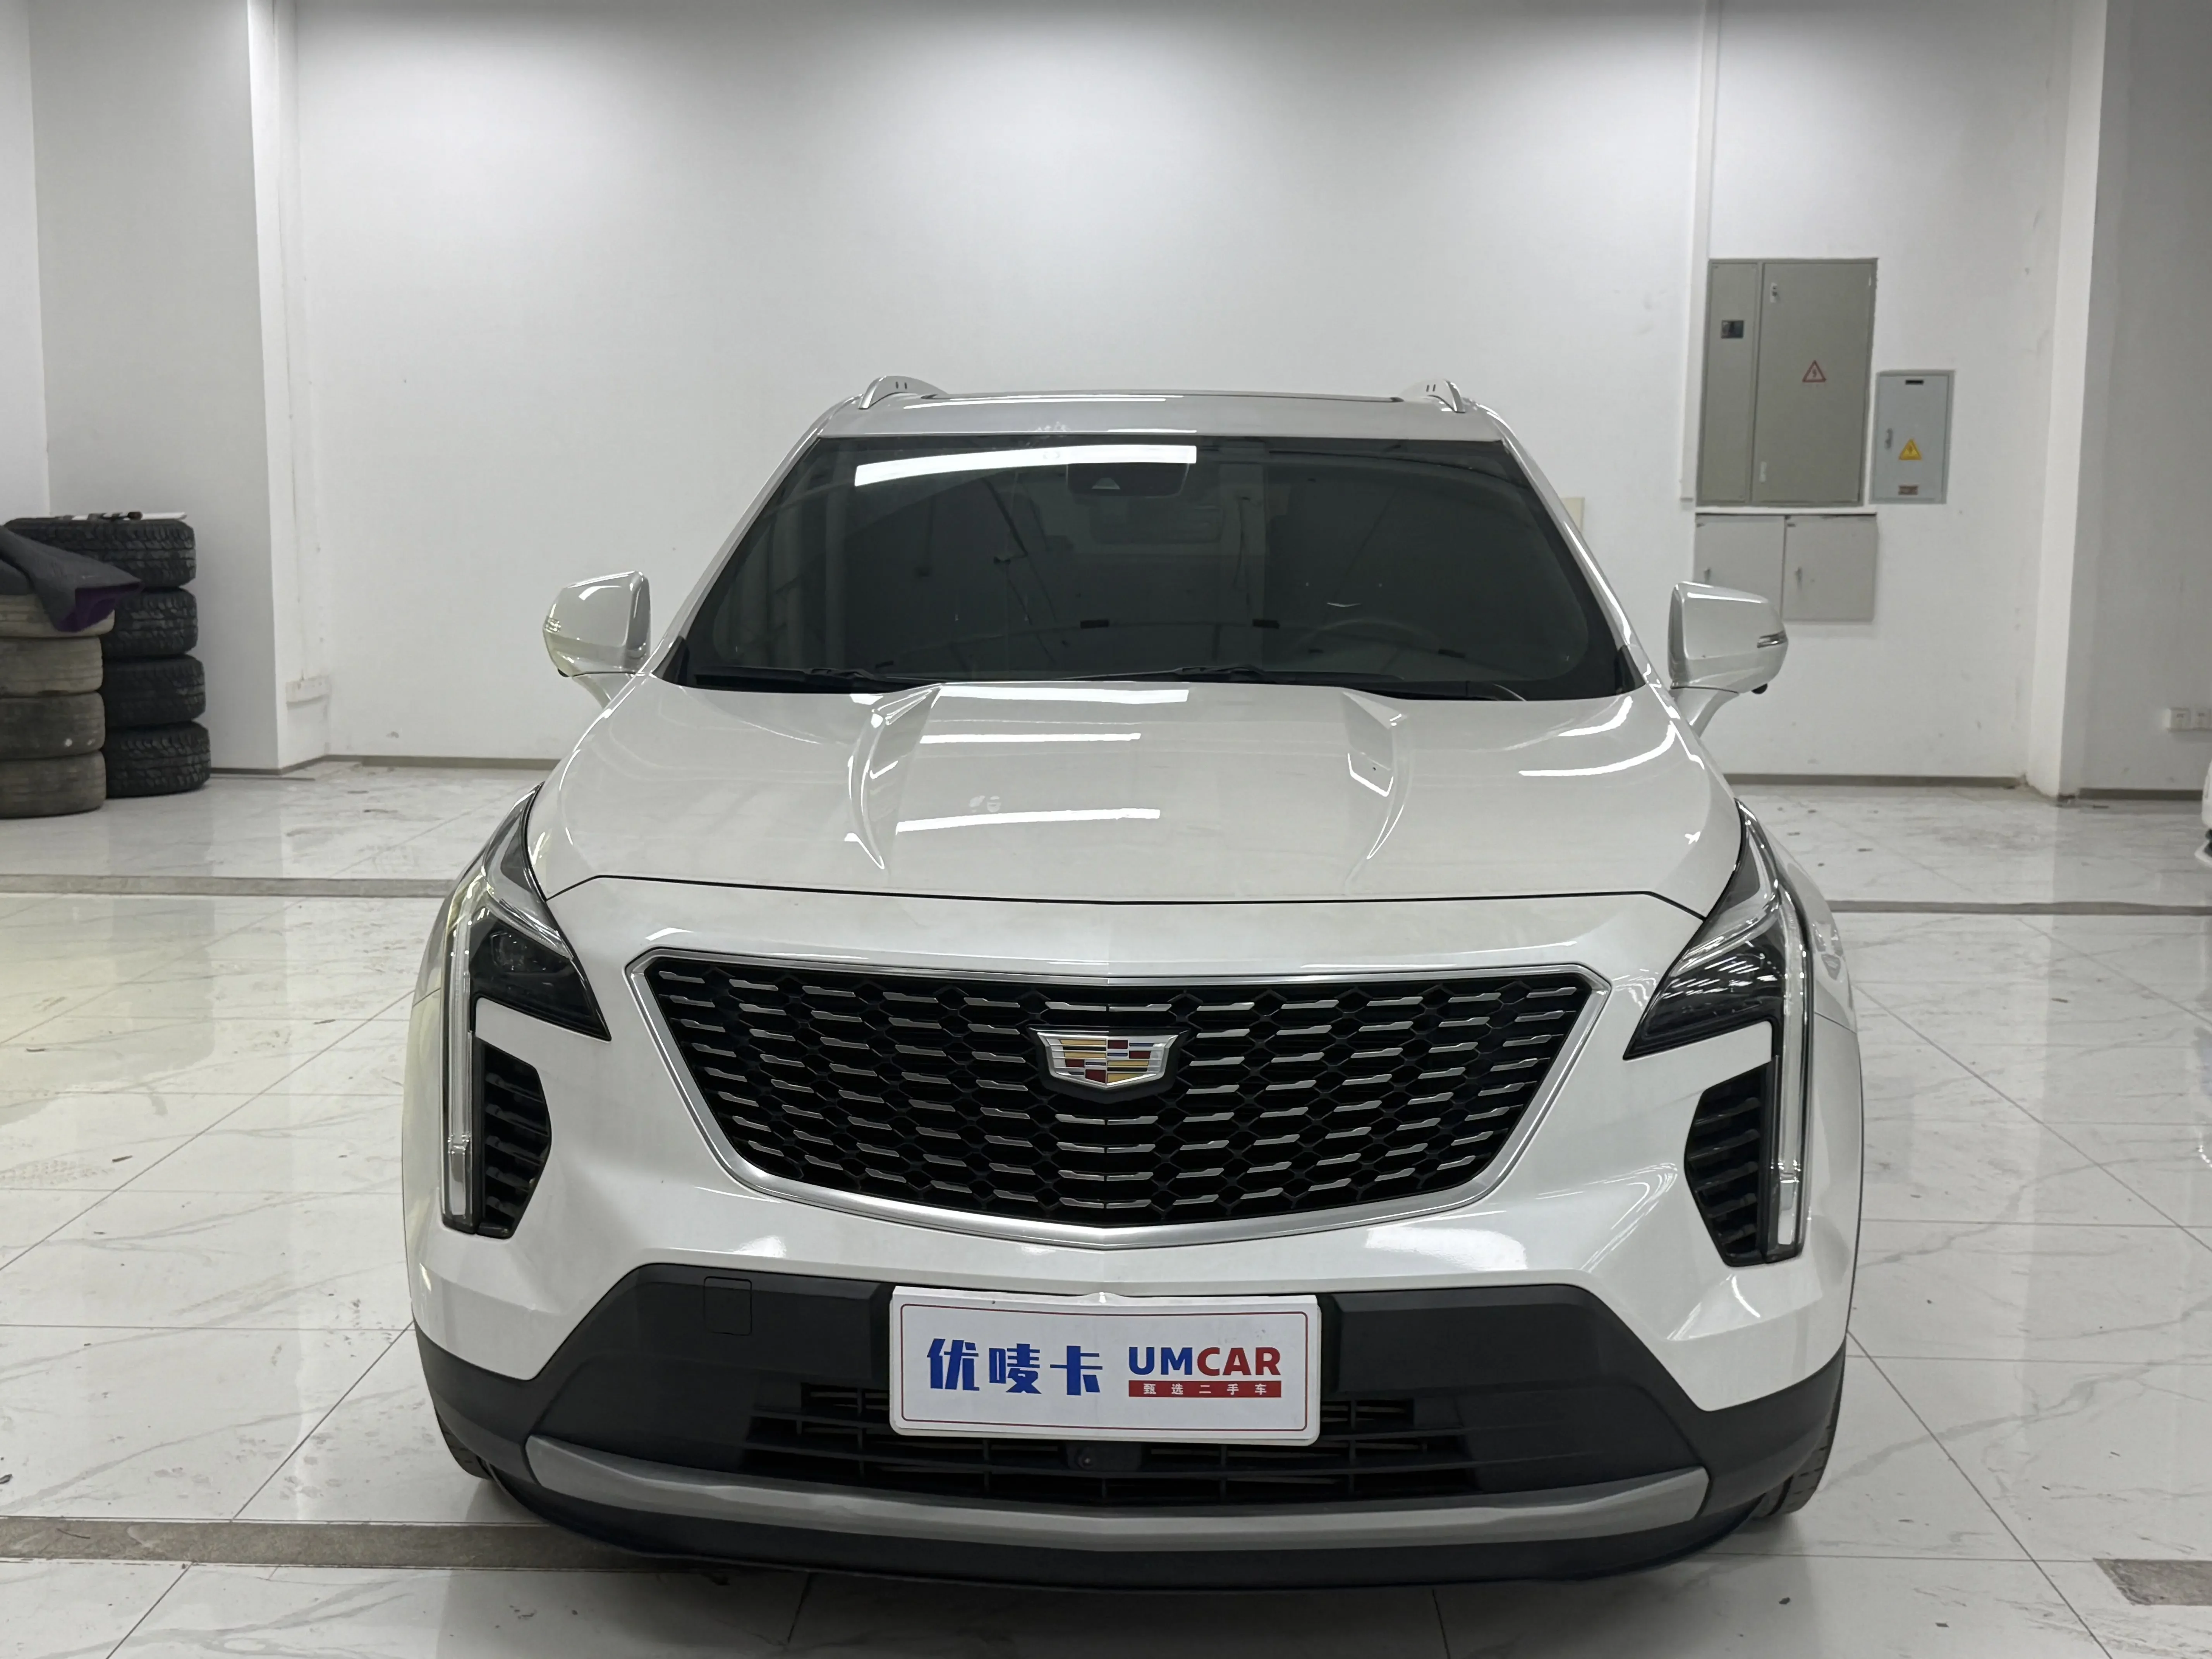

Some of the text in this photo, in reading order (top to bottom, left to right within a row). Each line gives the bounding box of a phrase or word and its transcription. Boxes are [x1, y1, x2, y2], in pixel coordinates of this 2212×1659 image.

[927, 1338, 1103, 1396] 优唛卡
[1129, 1346, 1281, 1376] UMCAR
[1143, 1383, 1267, 1395] 甄选二手车
